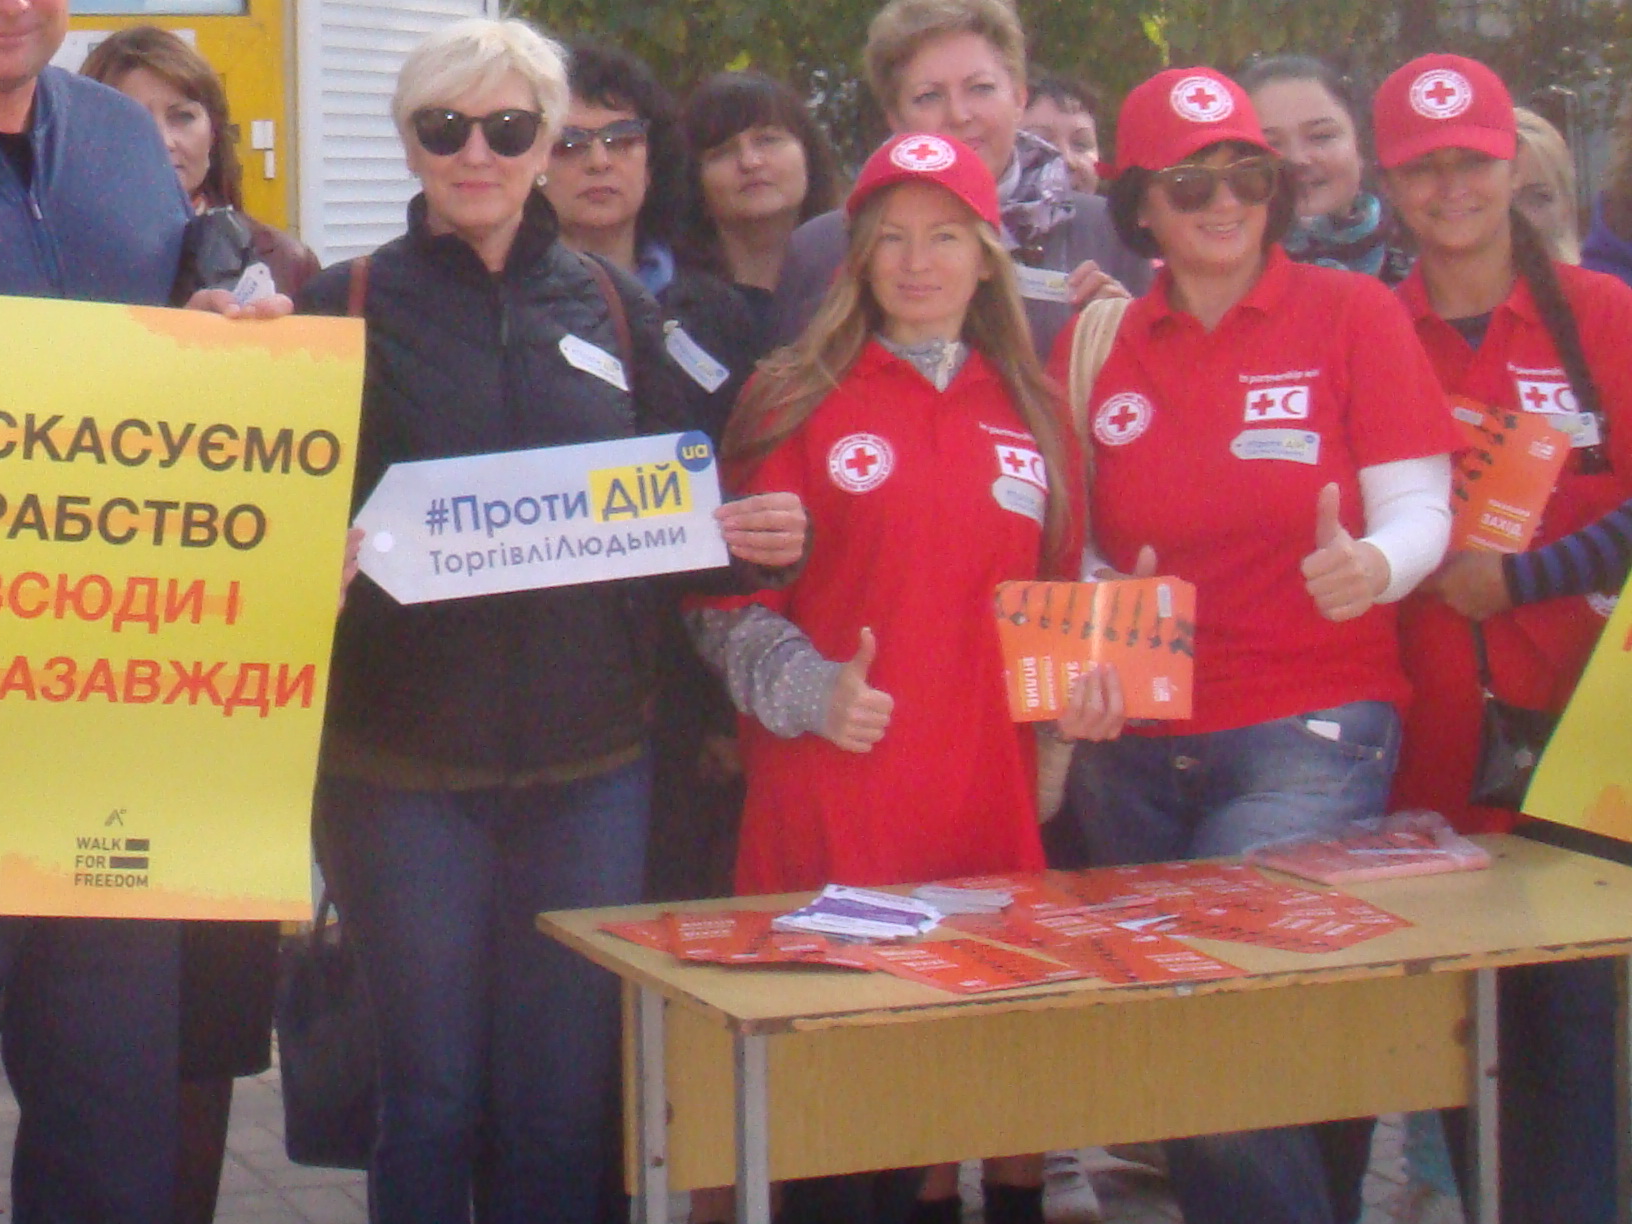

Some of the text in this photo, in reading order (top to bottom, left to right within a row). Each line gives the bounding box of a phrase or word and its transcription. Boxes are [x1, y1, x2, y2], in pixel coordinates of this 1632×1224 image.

[76, 837, 121, 851] WALK
[75, 855, 106, 869] FOR
[74, 873, 149, 888] FREEDOM
